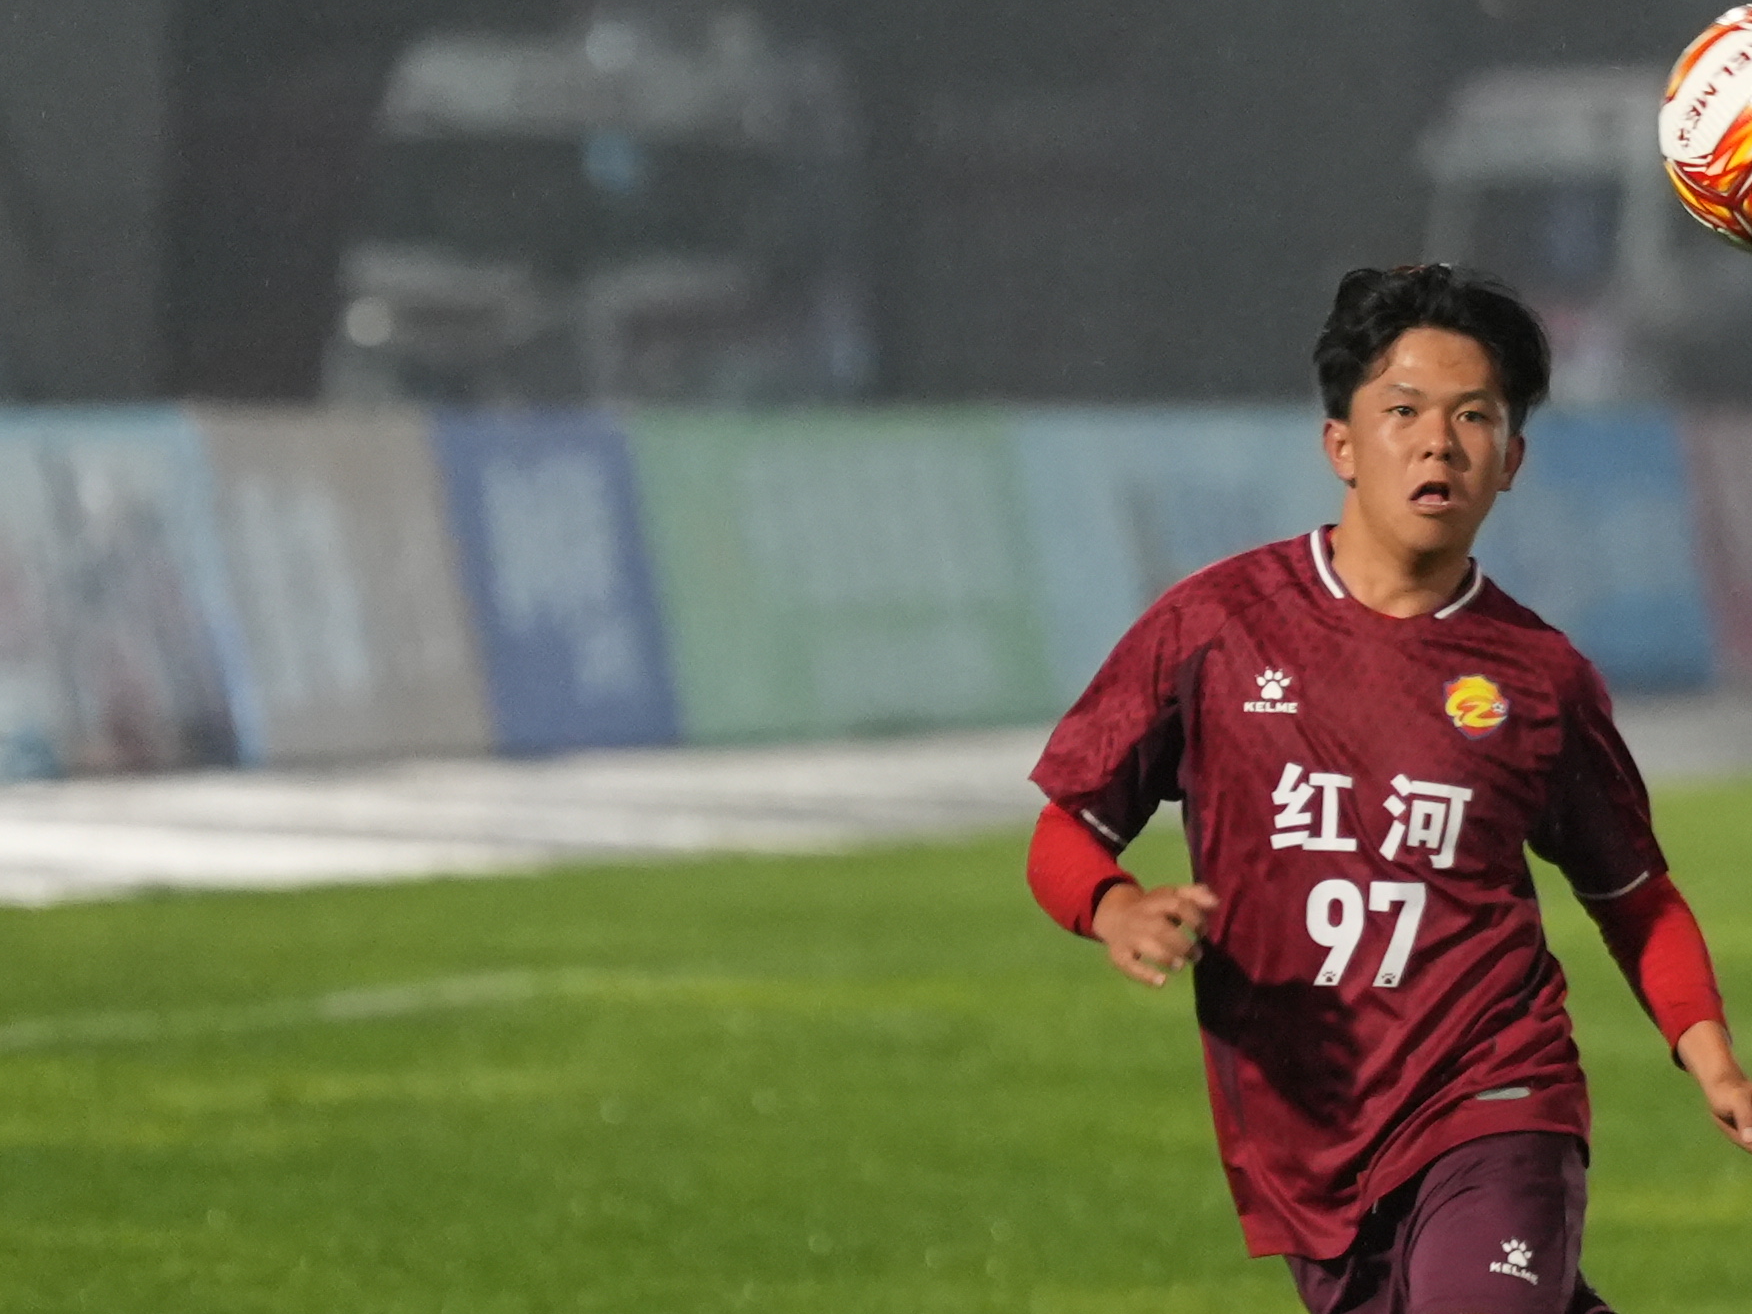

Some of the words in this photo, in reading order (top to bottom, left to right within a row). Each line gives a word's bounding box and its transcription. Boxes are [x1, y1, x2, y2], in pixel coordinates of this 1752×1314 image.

[1243, 701, 1298, 714] KELME
[1270, 762, 1473, 869] 红河
[1306, 878, 1427, 988] 97
[1489, 1261, 1538, 1285] KELME
